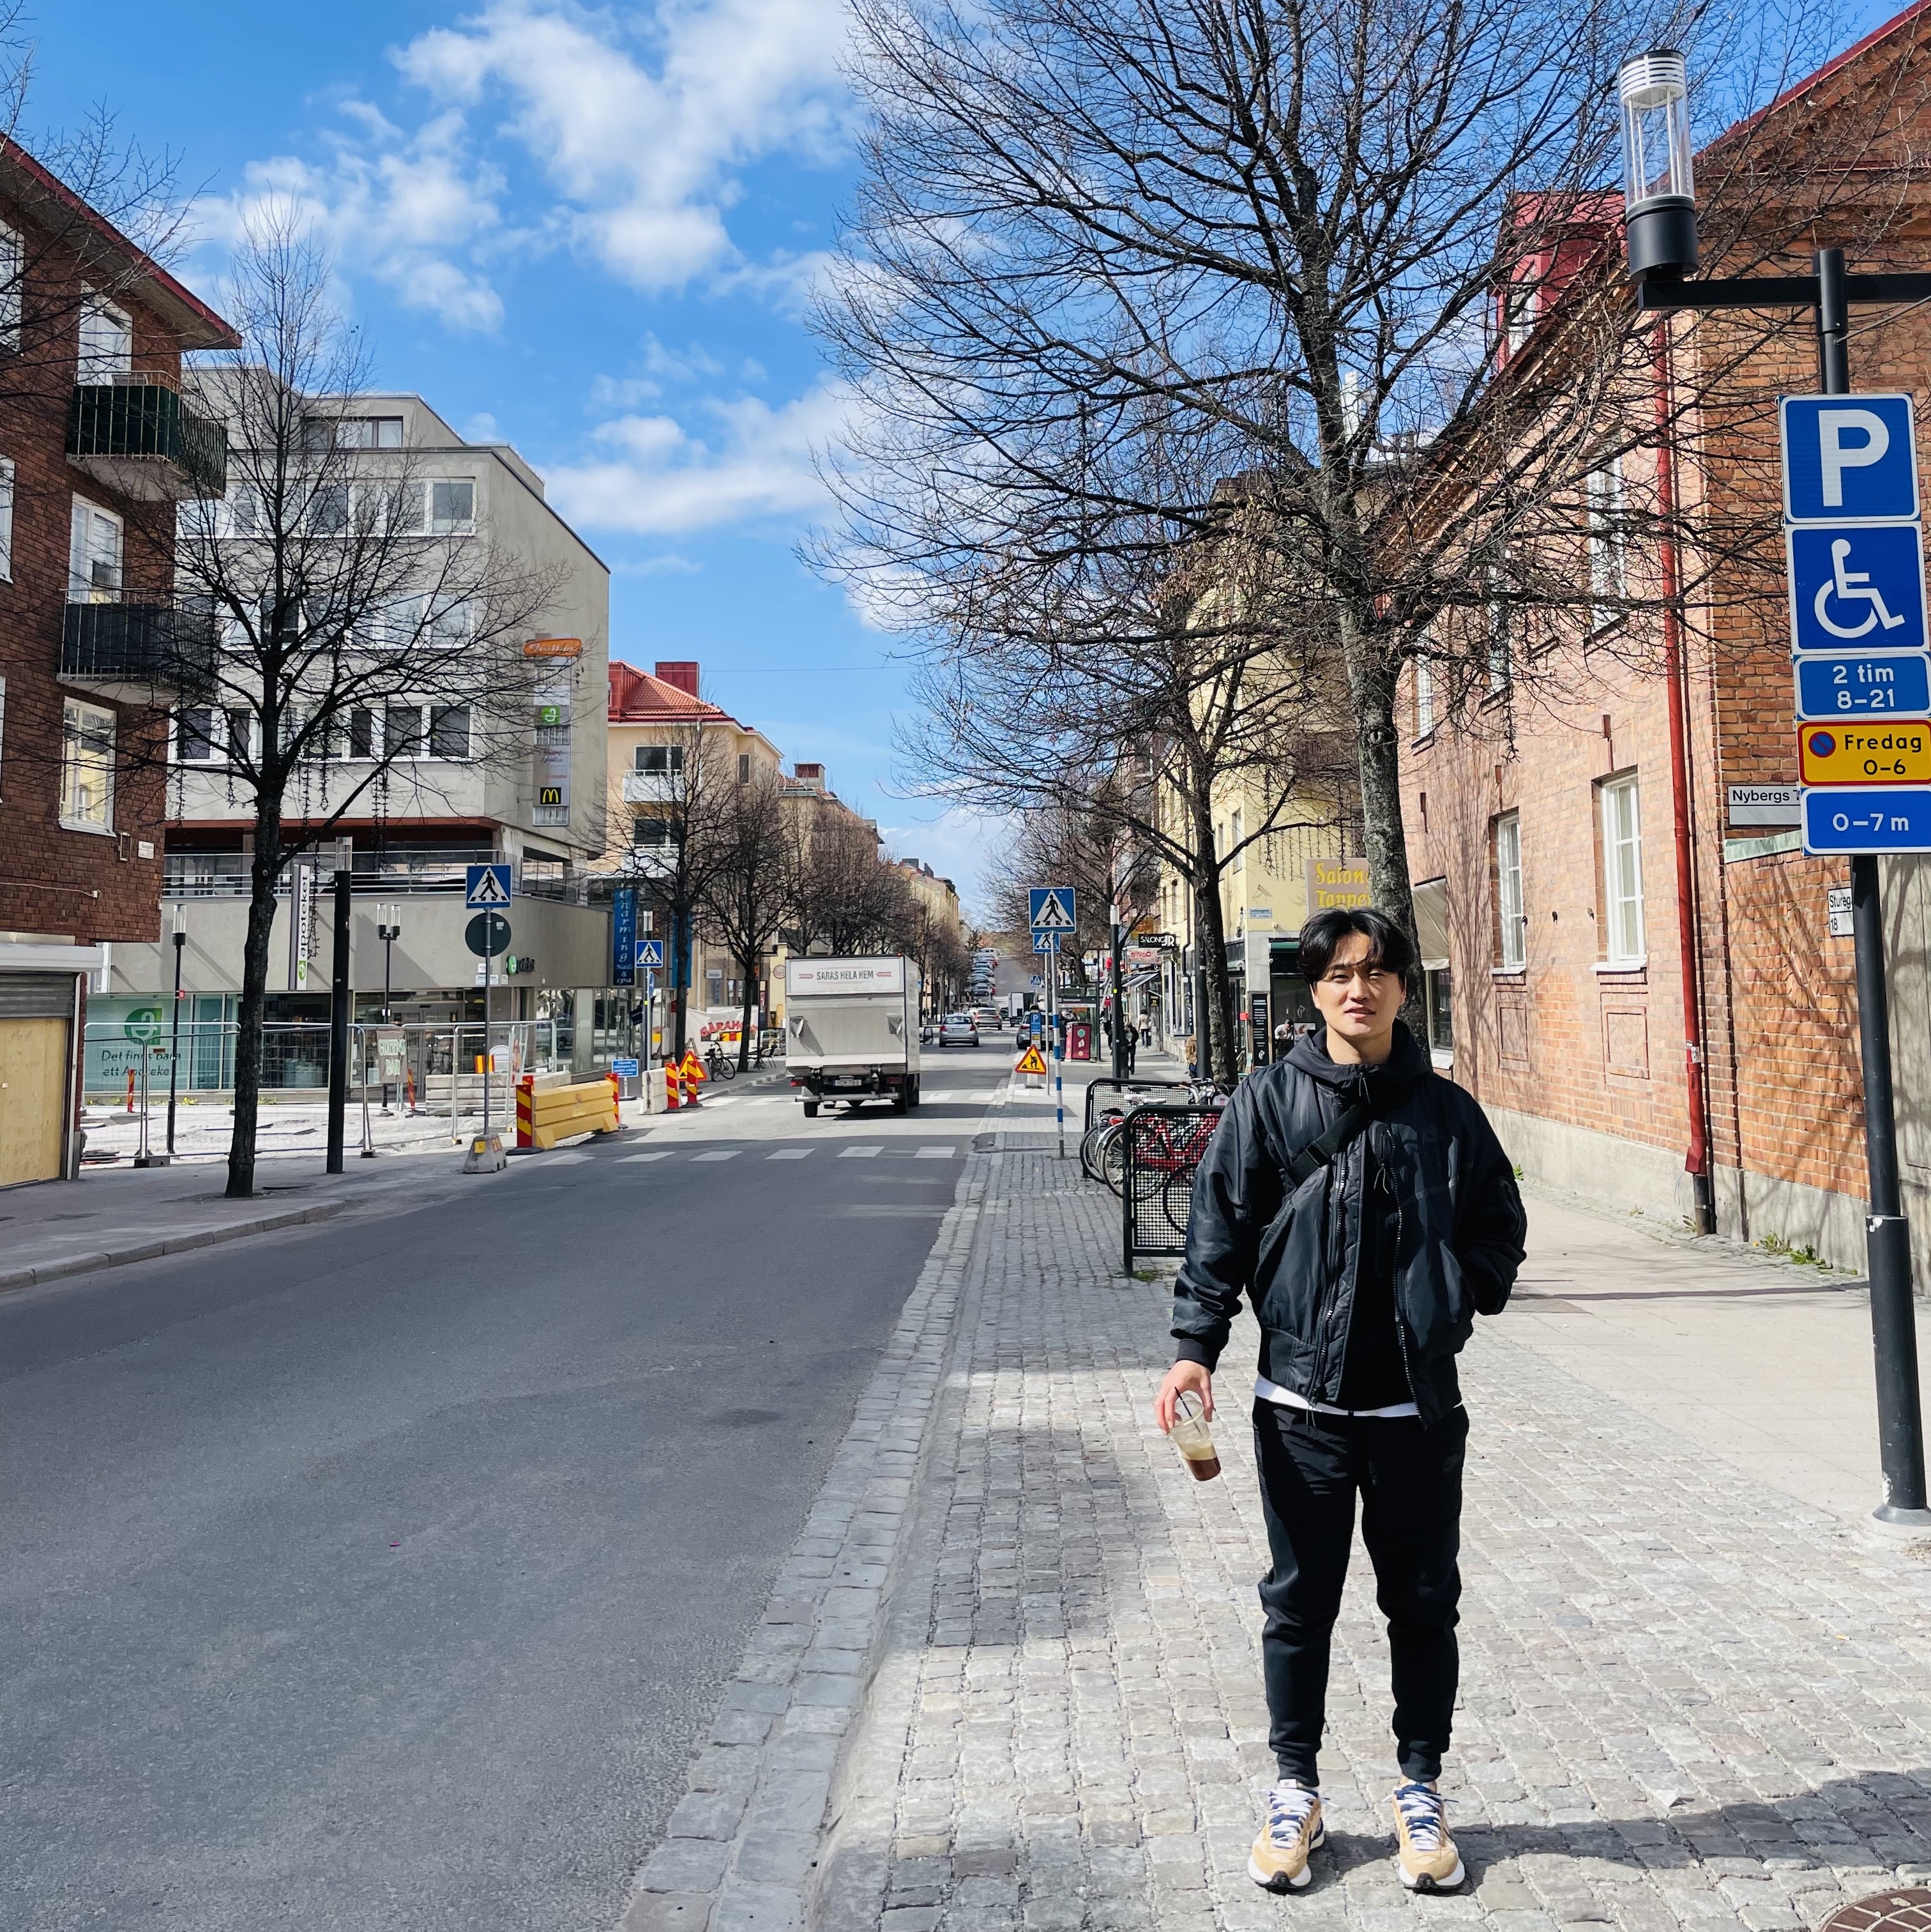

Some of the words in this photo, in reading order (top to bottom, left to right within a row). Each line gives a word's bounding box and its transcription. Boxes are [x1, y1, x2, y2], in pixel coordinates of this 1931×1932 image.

[1818, 409, 1890, 507] P
[1833, 665, 1848, 684] 2
[1857, 664, 1894, 683] tim
[1836, 688, 1895, 710] 8-21
[1845, 733, 1922, 753] Fredag
[1863, 759, 1907, 775] 0-6
[1732, 789, 1790, 803] Nybergs
[1832, 813, 1884, 832] 0-7
[1891, 817, 1909, 832] m
[1829, 895, 1852, 909] Stureg
[1831, 917, 1838, 931] 18
[1161, 935, 1175, 947] JR
[817, 971, 838, 980] SARAS
[840, 971, 857, 980] HELA
[859, 970, 874, 979] HEM
[102, 1050, 123, 1061] Det
[125, 1050, 153, 1061] fins
[103, 1067, 119, 1076] ett
[385, 1058, 401, 1076] BAR
